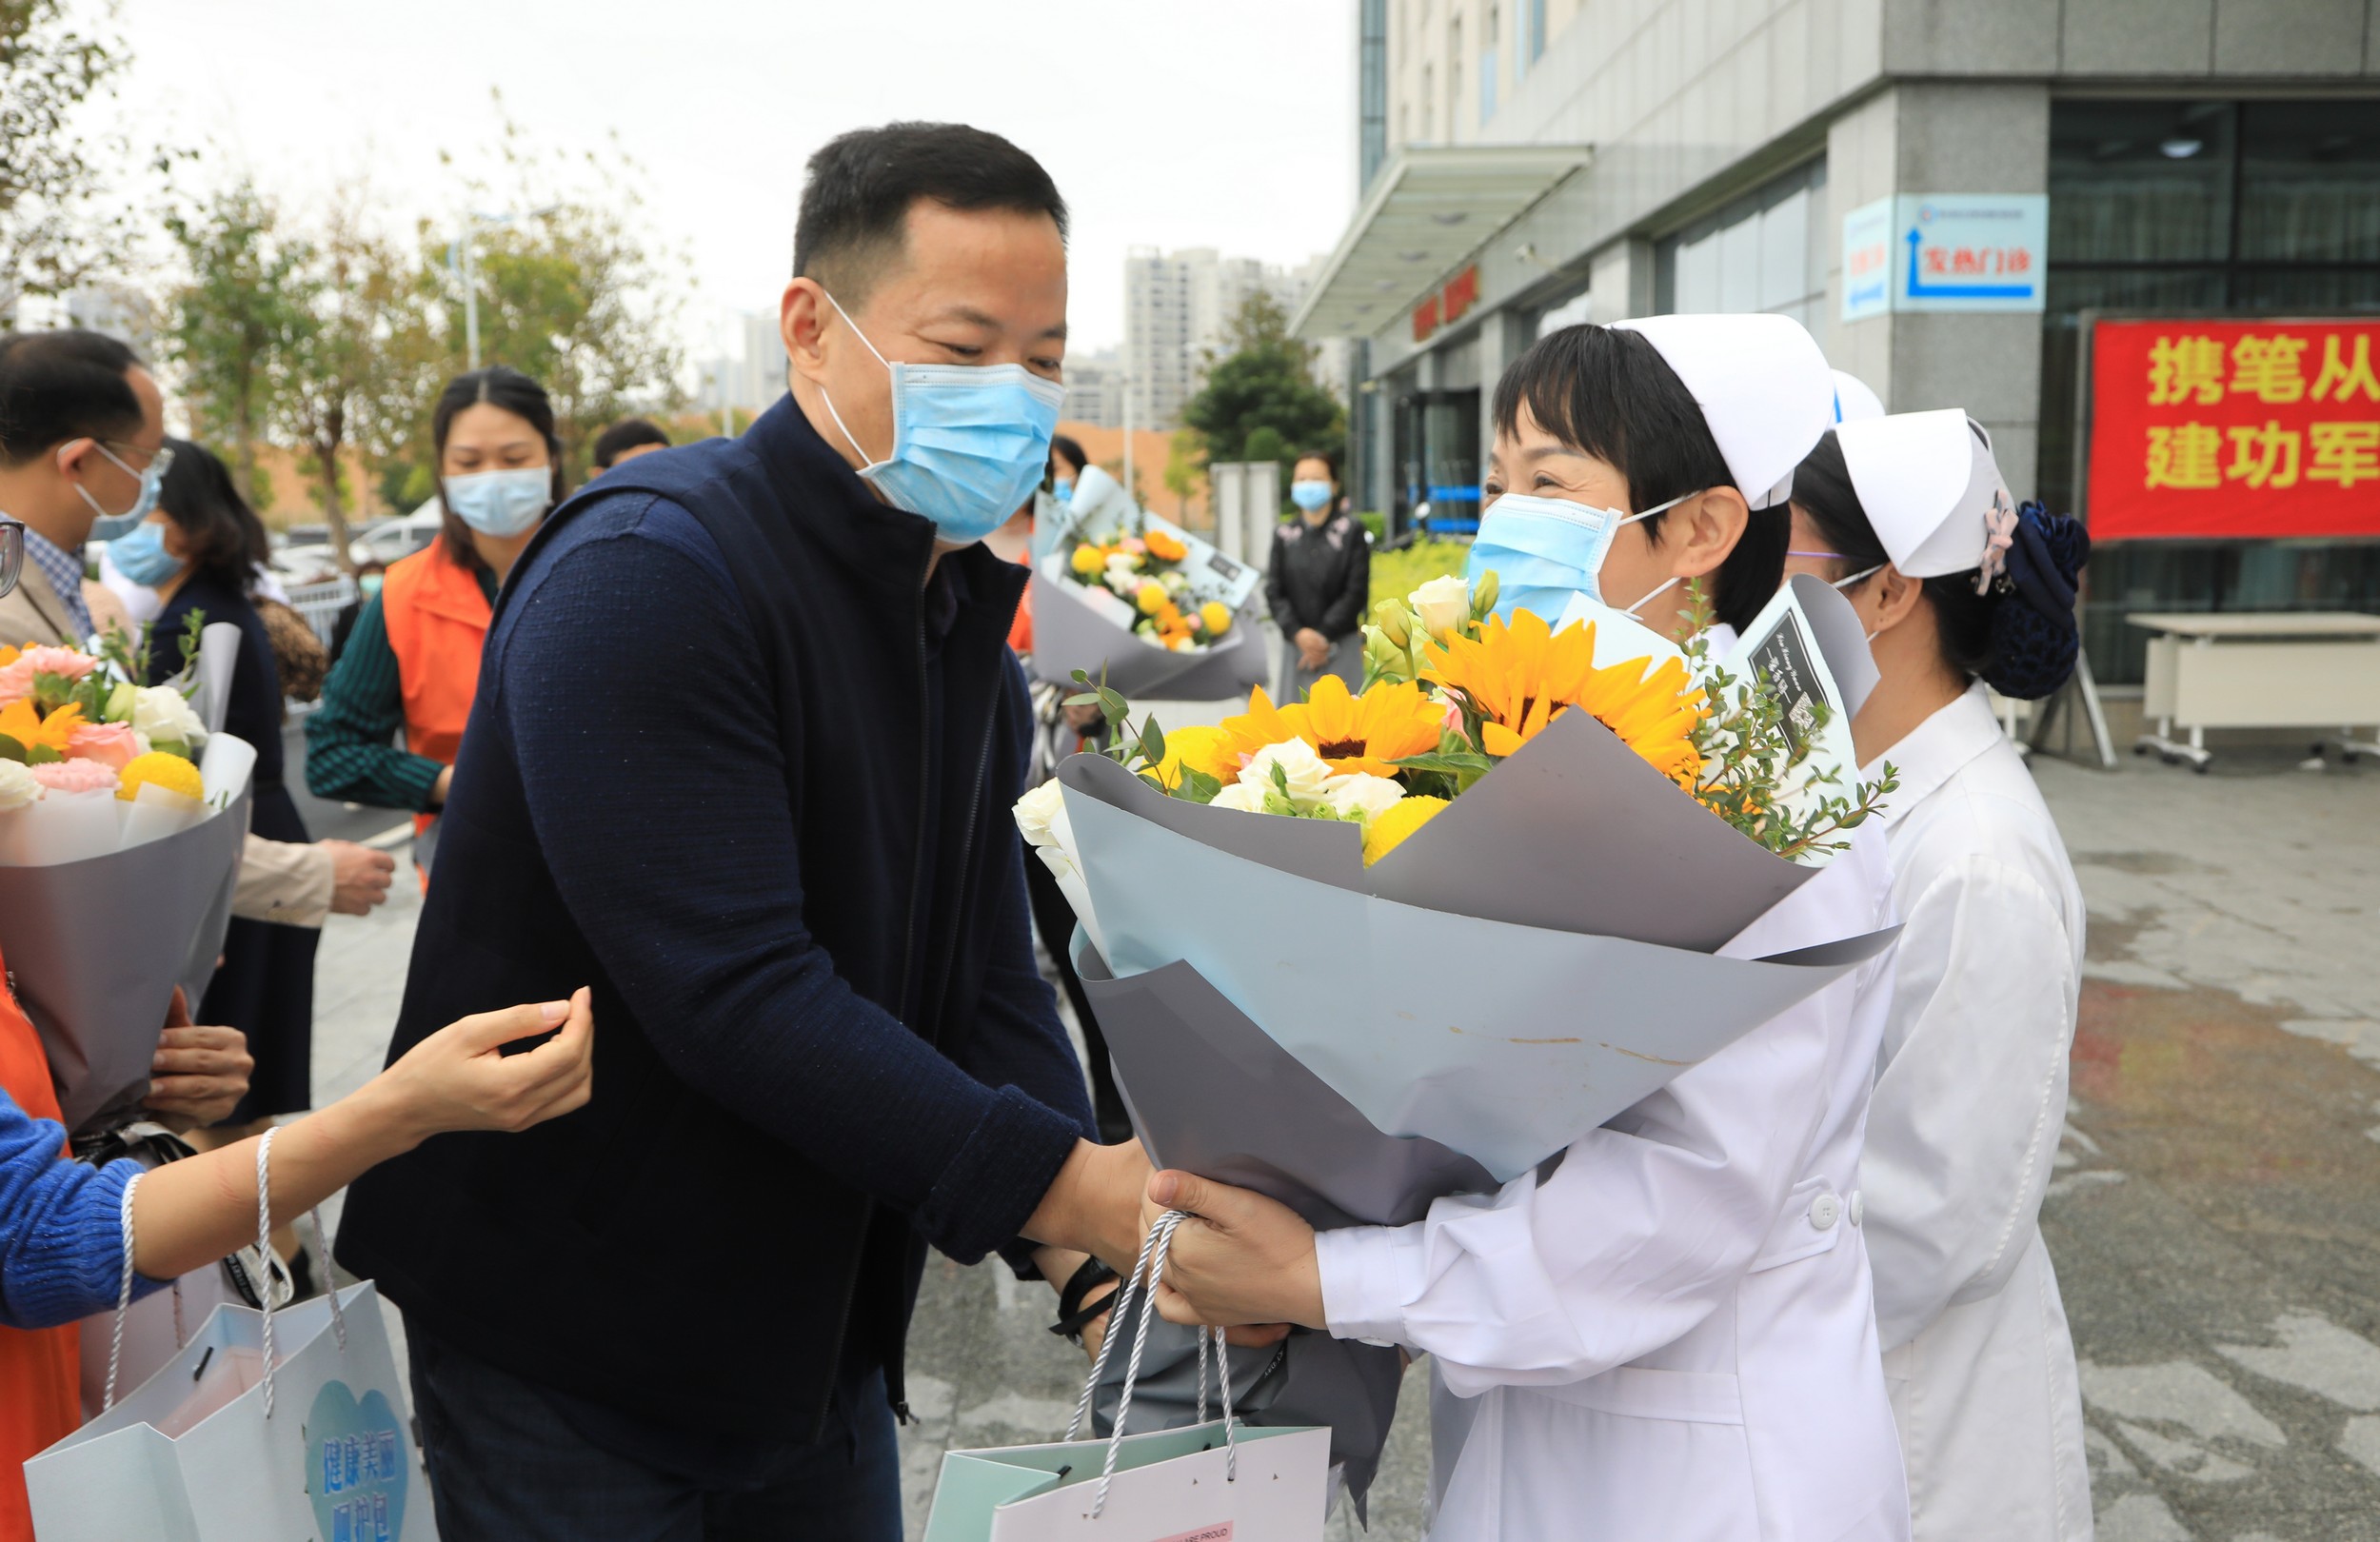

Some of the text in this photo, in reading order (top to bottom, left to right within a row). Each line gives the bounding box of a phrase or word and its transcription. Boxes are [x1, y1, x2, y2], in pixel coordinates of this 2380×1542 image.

[1925, 247, 2032, 275] 发热门诊
[2147, 334, 2380, 406] 携笔从
[2145, 420, 2380, 490] 建功军
[324, 1430, 395, 1496] 健康美丽
[1200, 1528, 1227, 1541] PROUD
